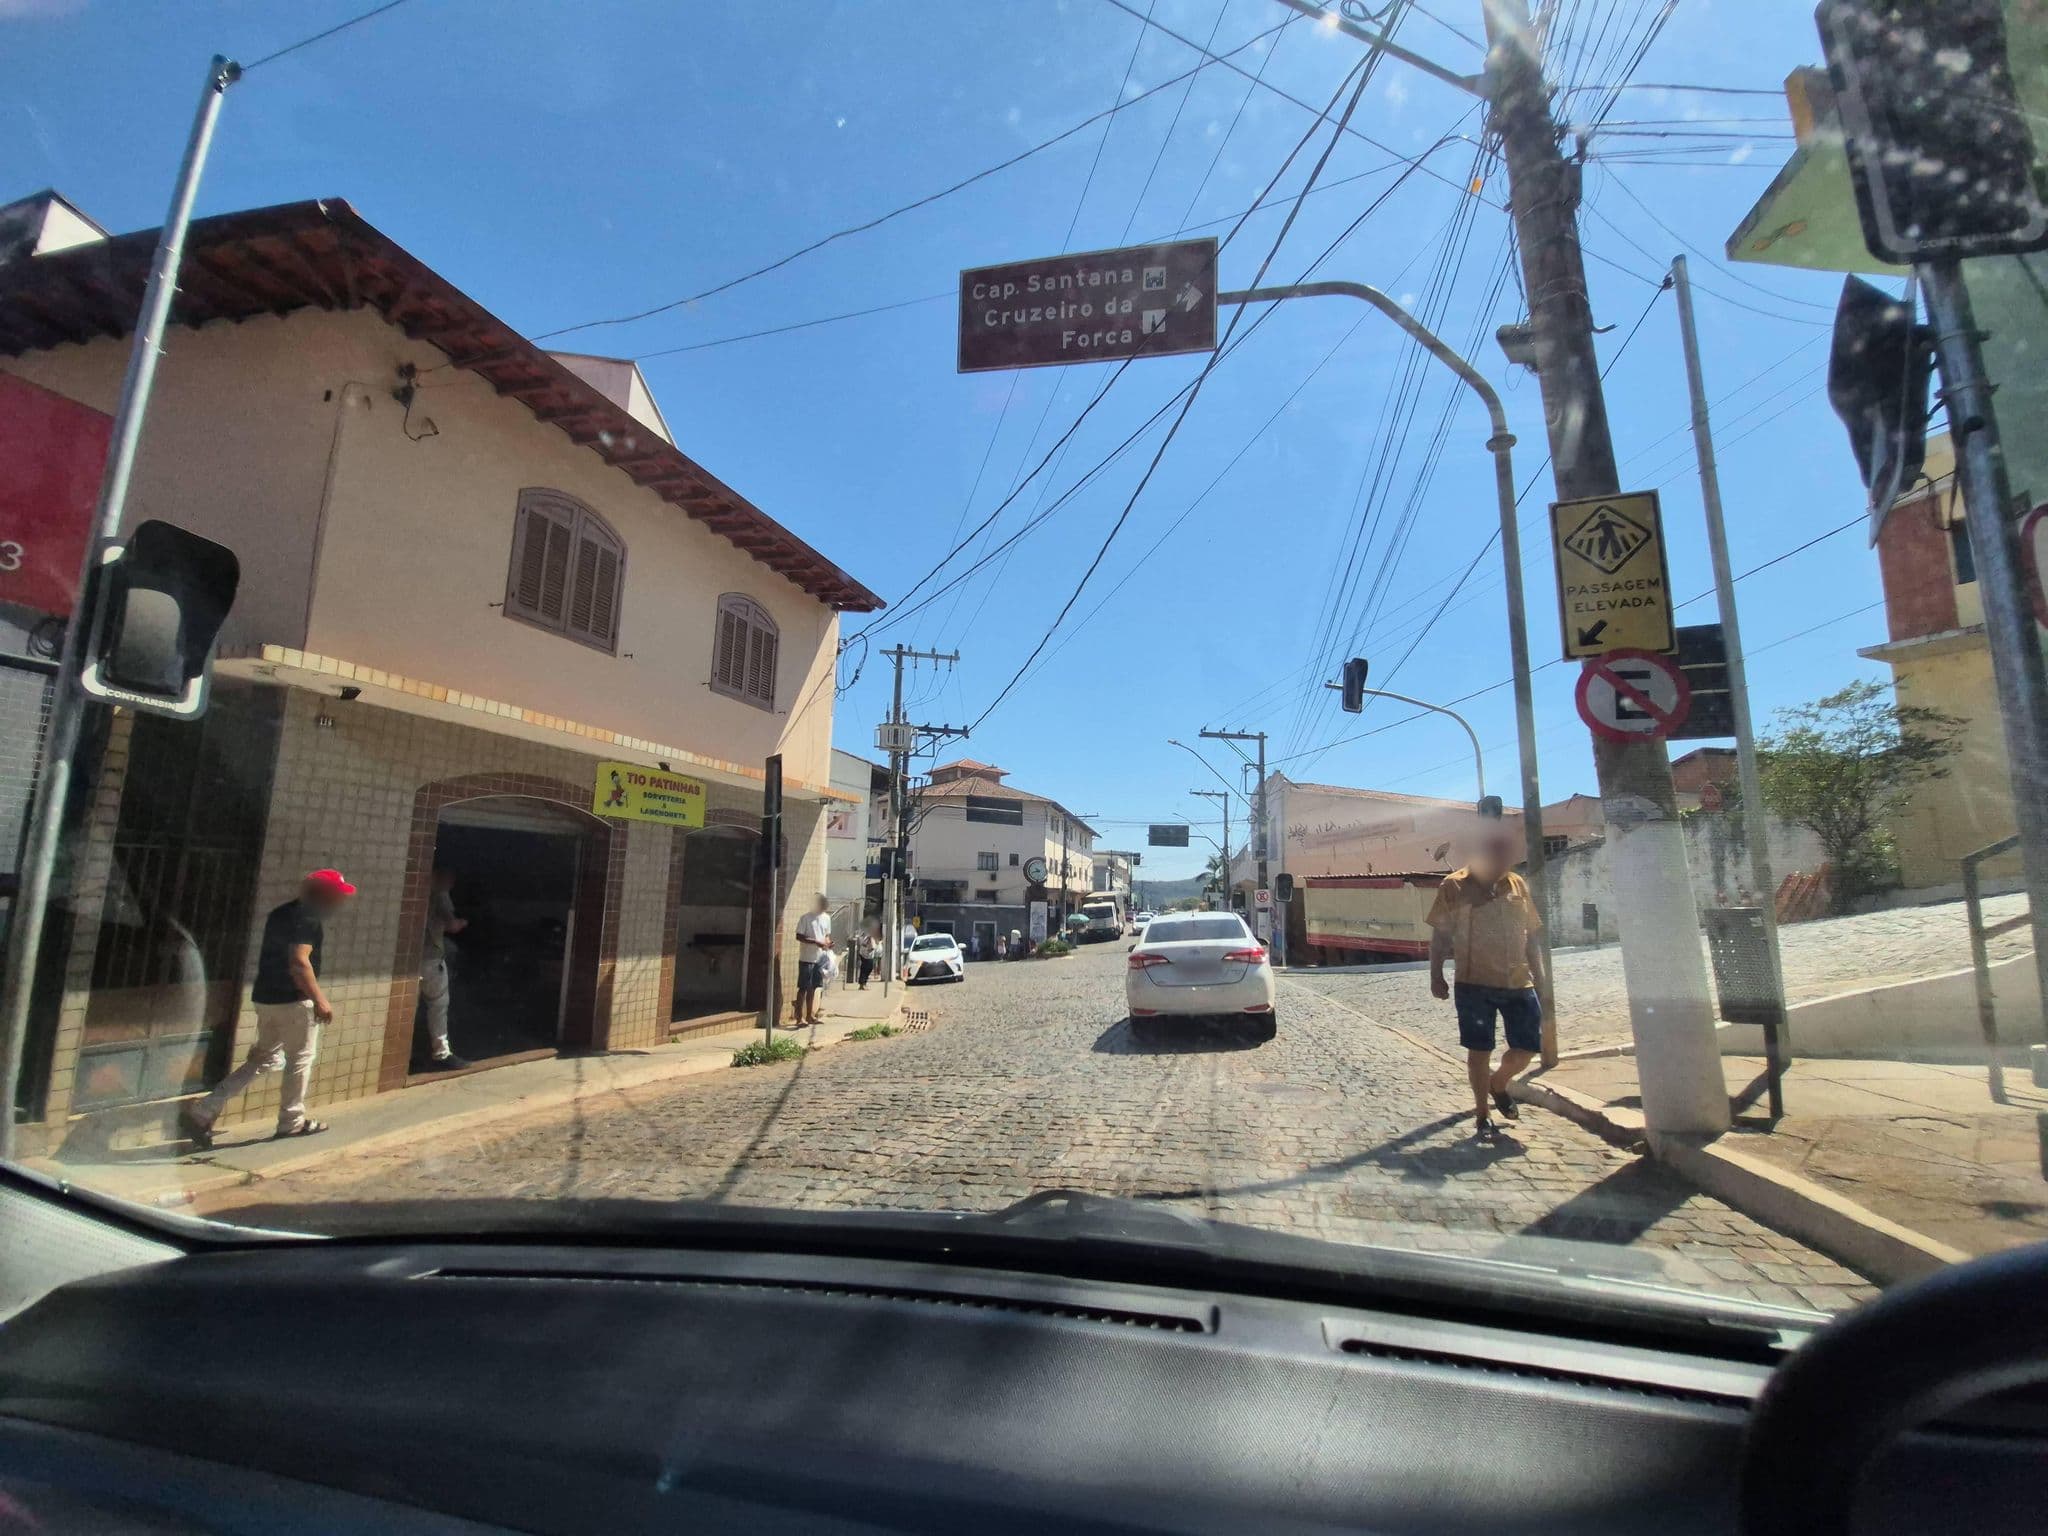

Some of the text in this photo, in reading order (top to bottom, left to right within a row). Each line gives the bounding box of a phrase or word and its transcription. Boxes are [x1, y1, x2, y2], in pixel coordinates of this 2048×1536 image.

[1027, 267, 1133, 293] Santana
[984, 297, 1133, 326] Cruzeiro da
[1062, 329, 1133, 349] Forca
[1566, 578, 1661, 597] PASSAGEM
[1574, 596, 1657, 613] ELEVADA
[626, 772, 701, 796] TIO PATINHAS
[642, 791, 687, 805] SORVETERIA
